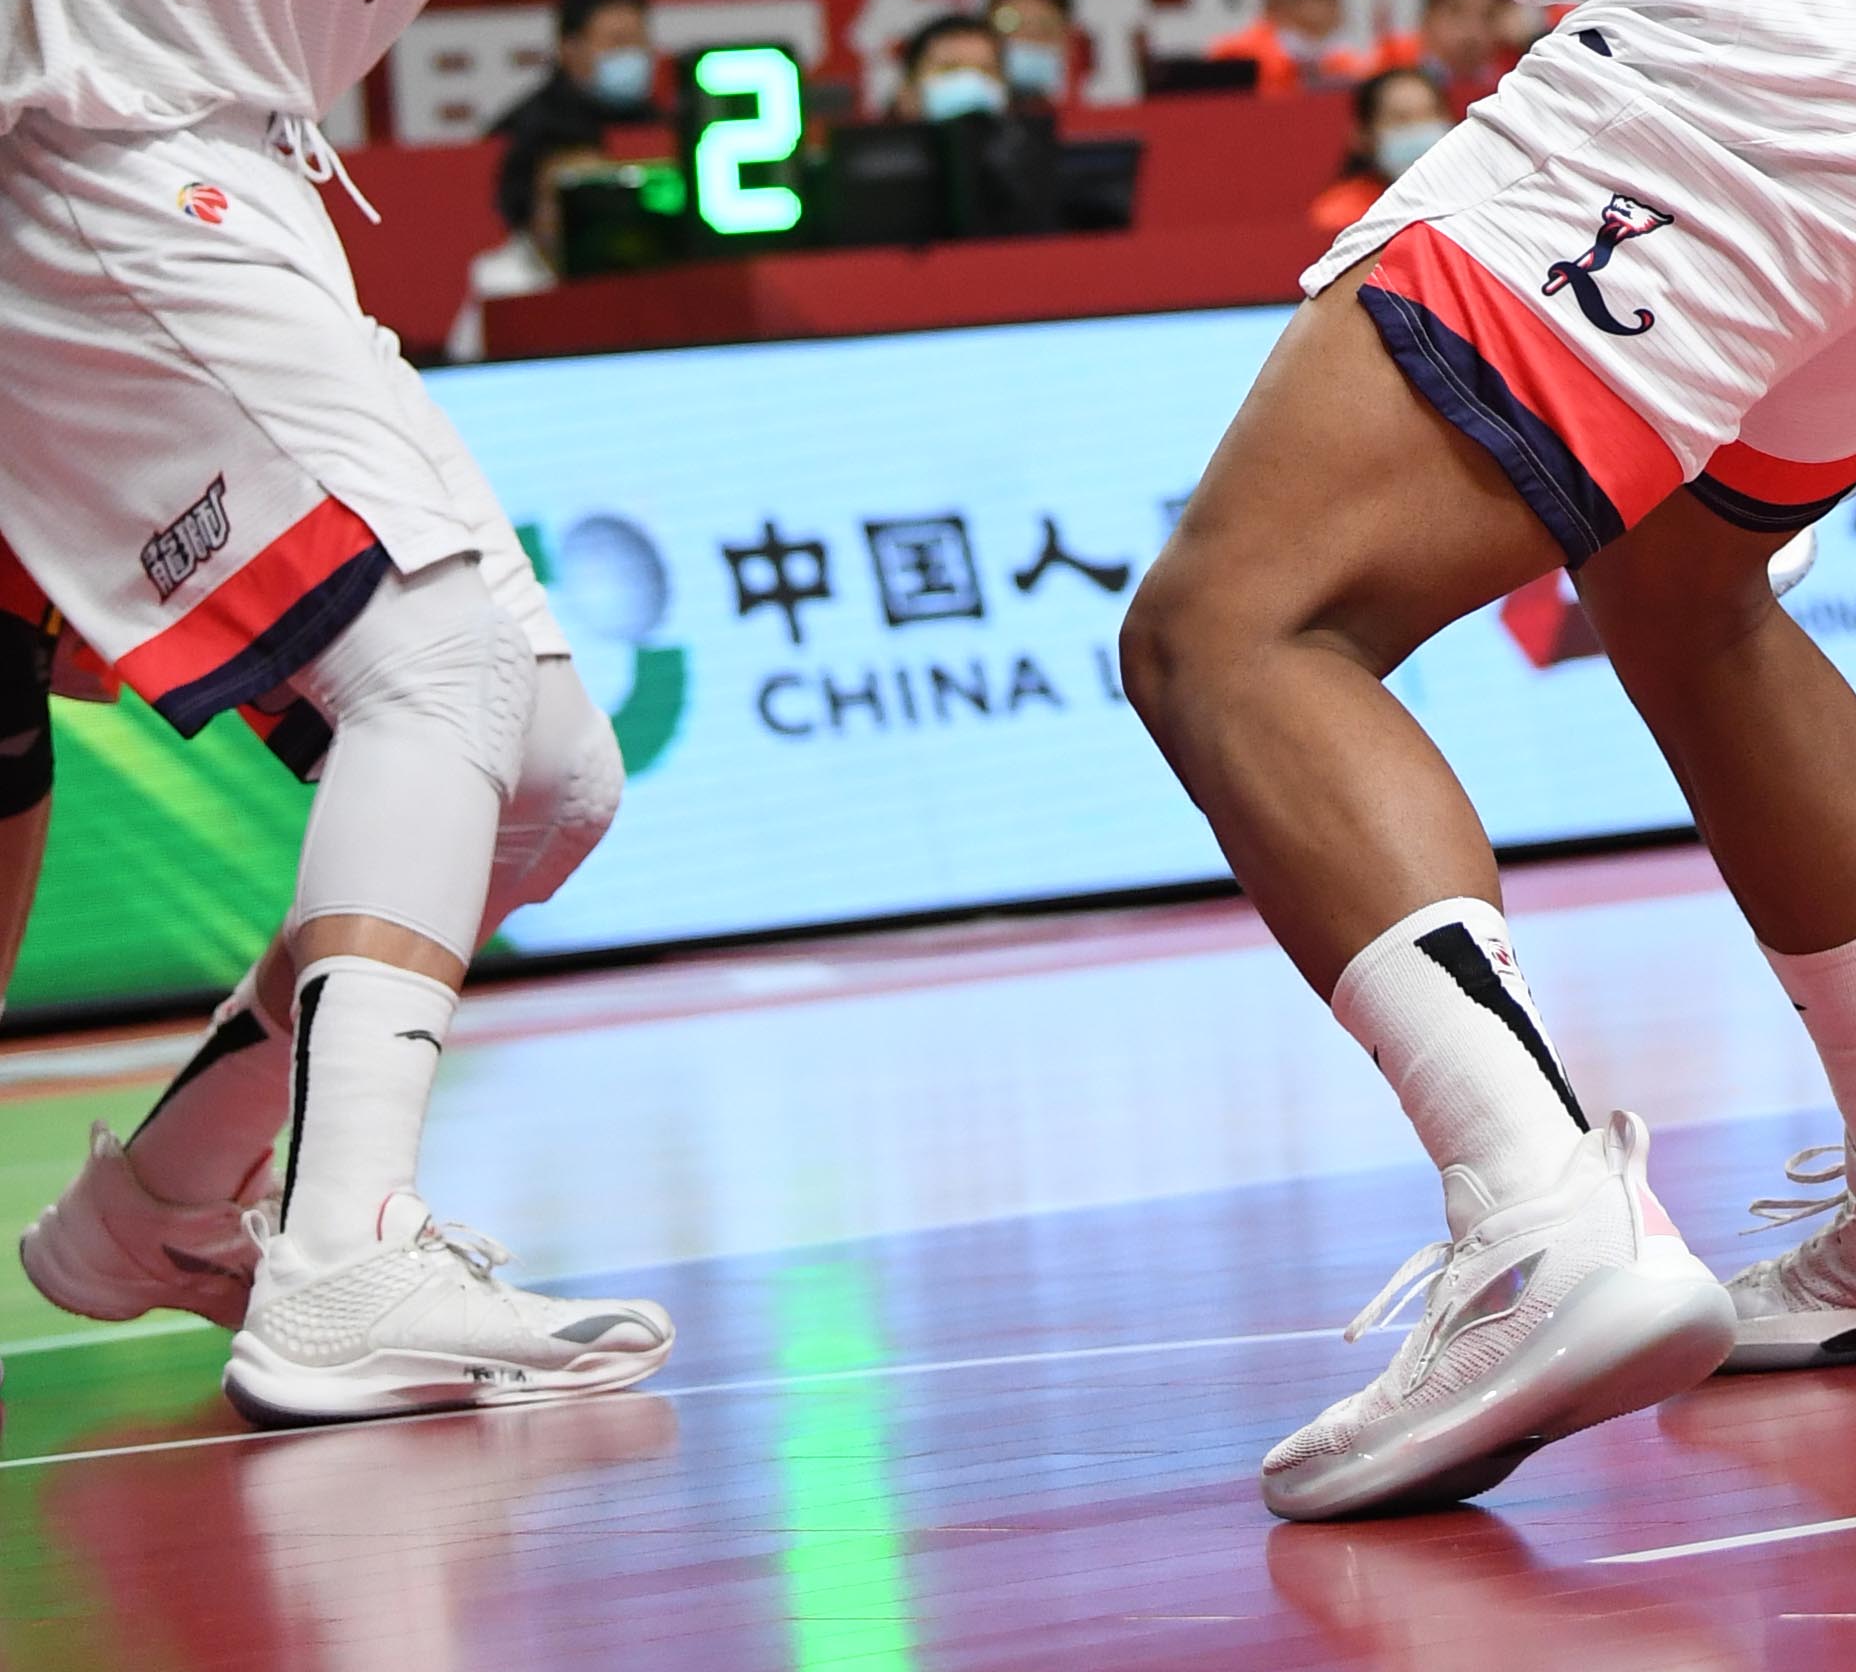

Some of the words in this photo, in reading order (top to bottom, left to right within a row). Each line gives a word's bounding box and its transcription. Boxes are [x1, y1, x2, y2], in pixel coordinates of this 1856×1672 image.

[695, 47, 803, 235] 2
[722, 492, 1192, 646] 中国人
[755, 654, 1064, 739] CHINA
[1094, 644, 1124, 704] L
